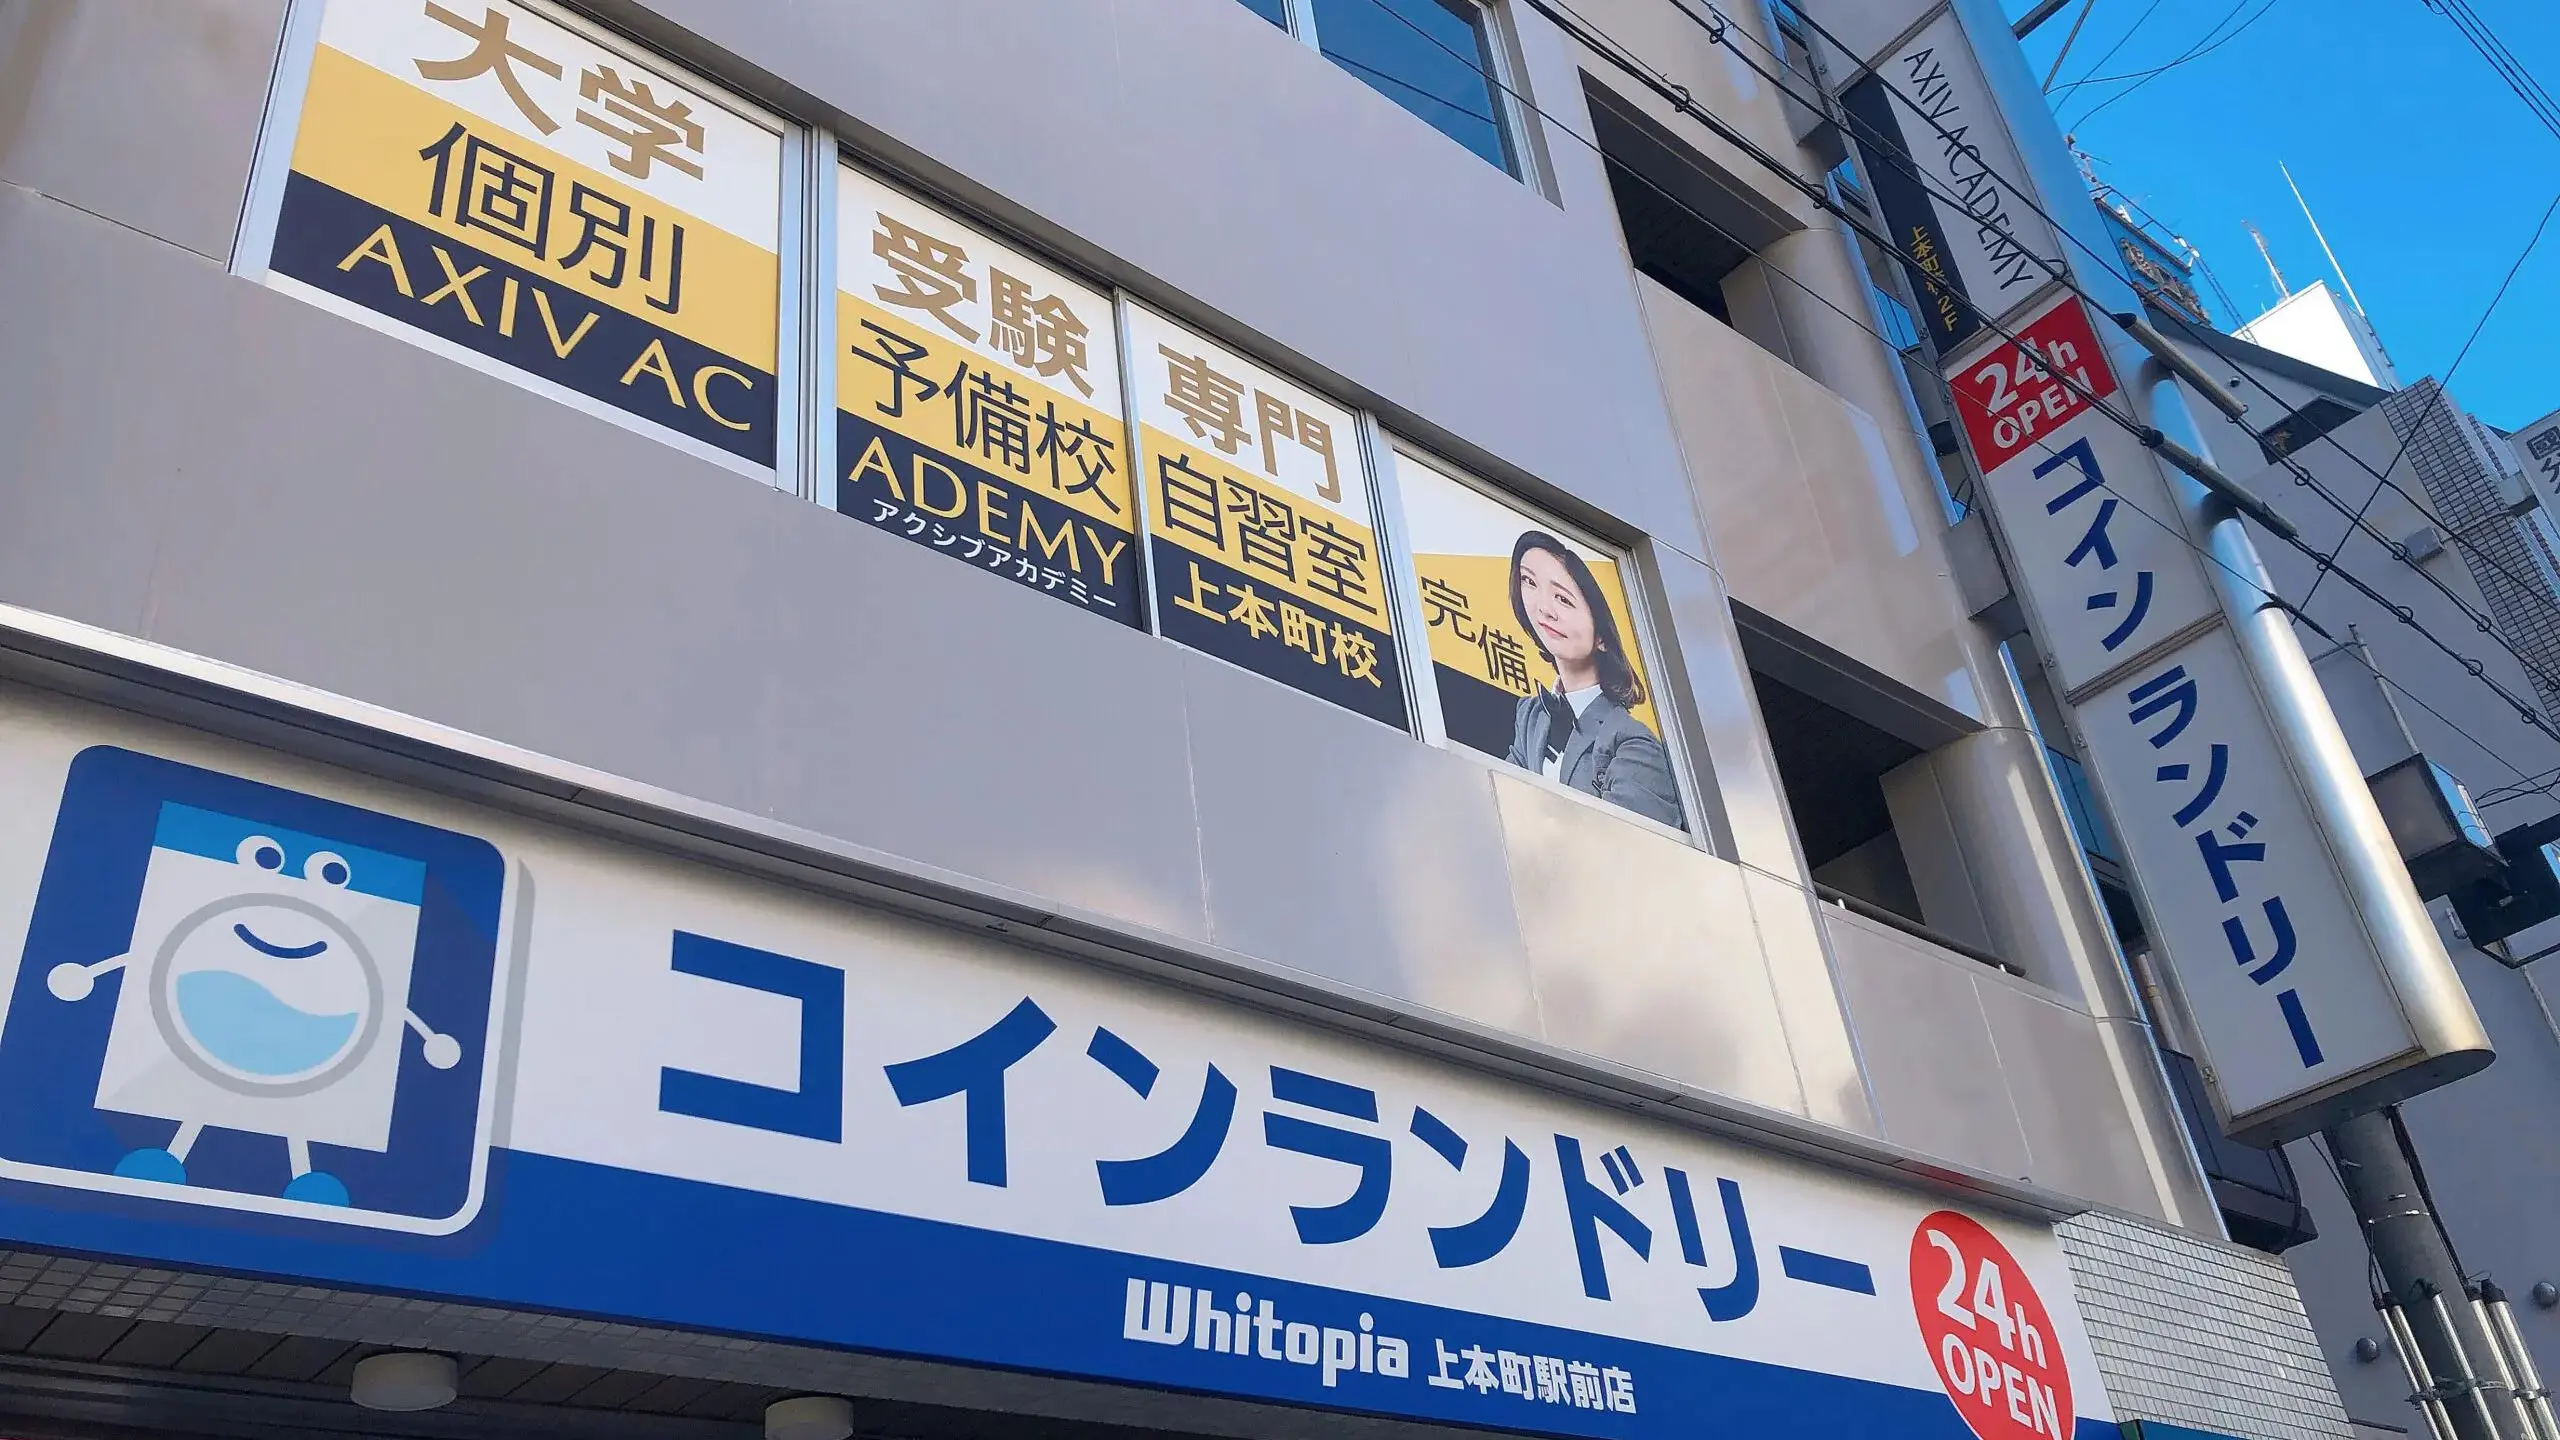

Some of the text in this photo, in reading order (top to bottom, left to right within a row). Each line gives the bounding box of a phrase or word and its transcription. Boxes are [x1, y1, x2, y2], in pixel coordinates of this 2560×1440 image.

[1903, 47, 2034, 290] AXIV ACADEMY
[336, 223, 601, 360] AXIV
[411, 0, 1342, 505] 大学 受験 専門
[418, 121, 1531, 694] 個別 予備校 自習室 完備
[1974, 336, 2079, 418] 24h
[1993, 366, 2095, 449] OPEN
[873, 498, 1117, 608] アクシブアカデミー
[1172, 560, 1385, 689] 上本町校
[658, 929, 1877, 1322] コインランドリー
[1123, 1277, 1637, 1415] Whitopia 上本町駅前店
[1926, 1229, 2048, 1370] 24h
[1942, 1333, 2063, 1440] OPEN
